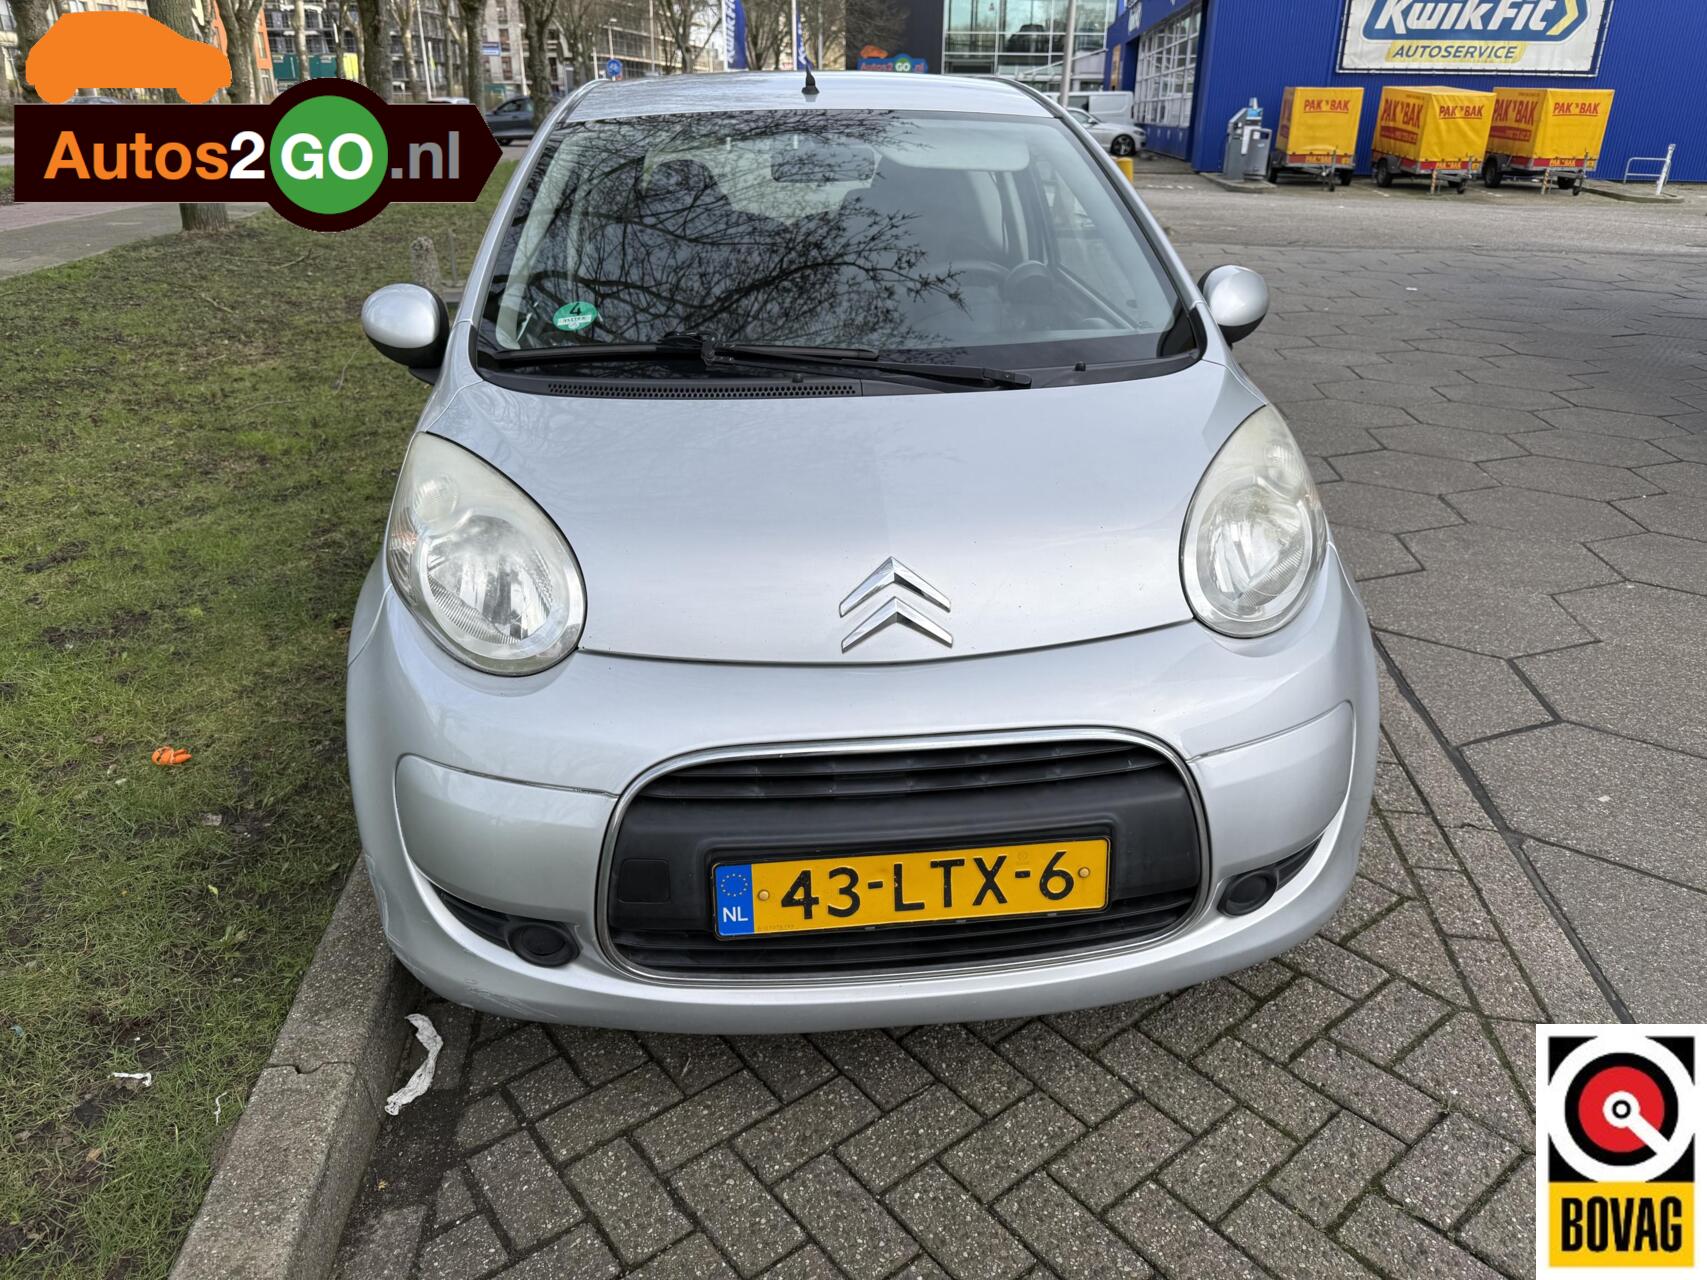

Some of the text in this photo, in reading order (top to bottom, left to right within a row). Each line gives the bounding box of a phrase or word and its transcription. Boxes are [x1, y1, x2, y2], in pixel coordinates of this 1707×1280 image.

[1392, 44, 1519, 59] AUTOSERVICE
[1304, 99, 1323, 112] PAK
[1330, 99, 1350, 112] BAK
[1381, 97, 1424, 128] PAK BAK
[1439, 104, 1458, 117] PAK
[1464, 104, 1484, 117] BAK
[1514, 100, 1538, 126] BAK
[1553, 102, 1573, 114] PAK
[1579, 102, 1600, 114] BAK
[569, 302, 582, 315] 4
[781, 851, 1075, 920] 43-LTX-6
[722, 906, 748, 923] NL
